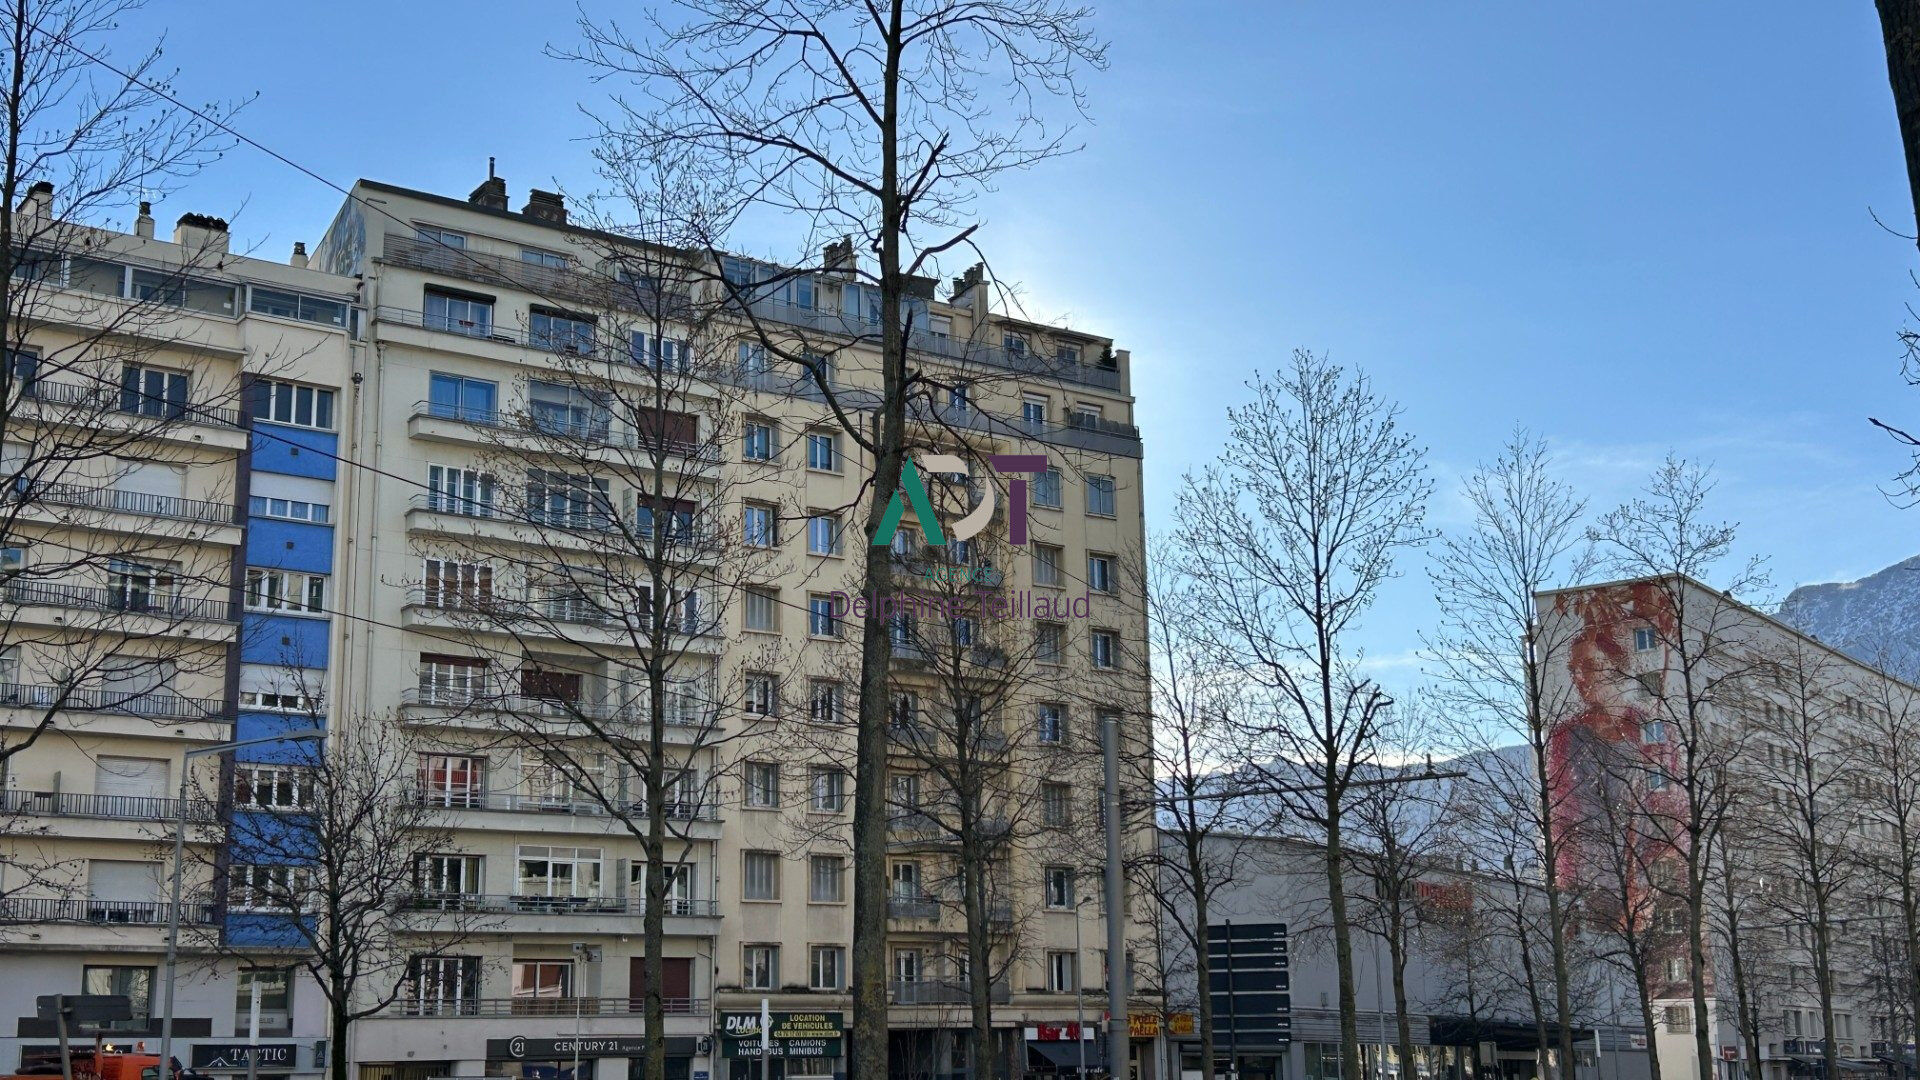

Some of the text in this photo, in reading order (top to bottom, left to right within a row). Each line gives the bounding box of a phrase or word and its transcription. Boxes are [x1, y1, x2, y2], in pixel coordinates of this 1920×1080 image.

[789, 1014, 826, 1022] LOCATION
[725, 1016, 756, 1030] DLM
[781, 1022, 793, 1030] DE
[554, 1041, 606, 1052] CENTURY
[608, 1041, 618, 1051] 21
[738, 1039, 827, 1047] VOITUES CAMIONS
[789, 1047, 823, 1055] MINIBUS
